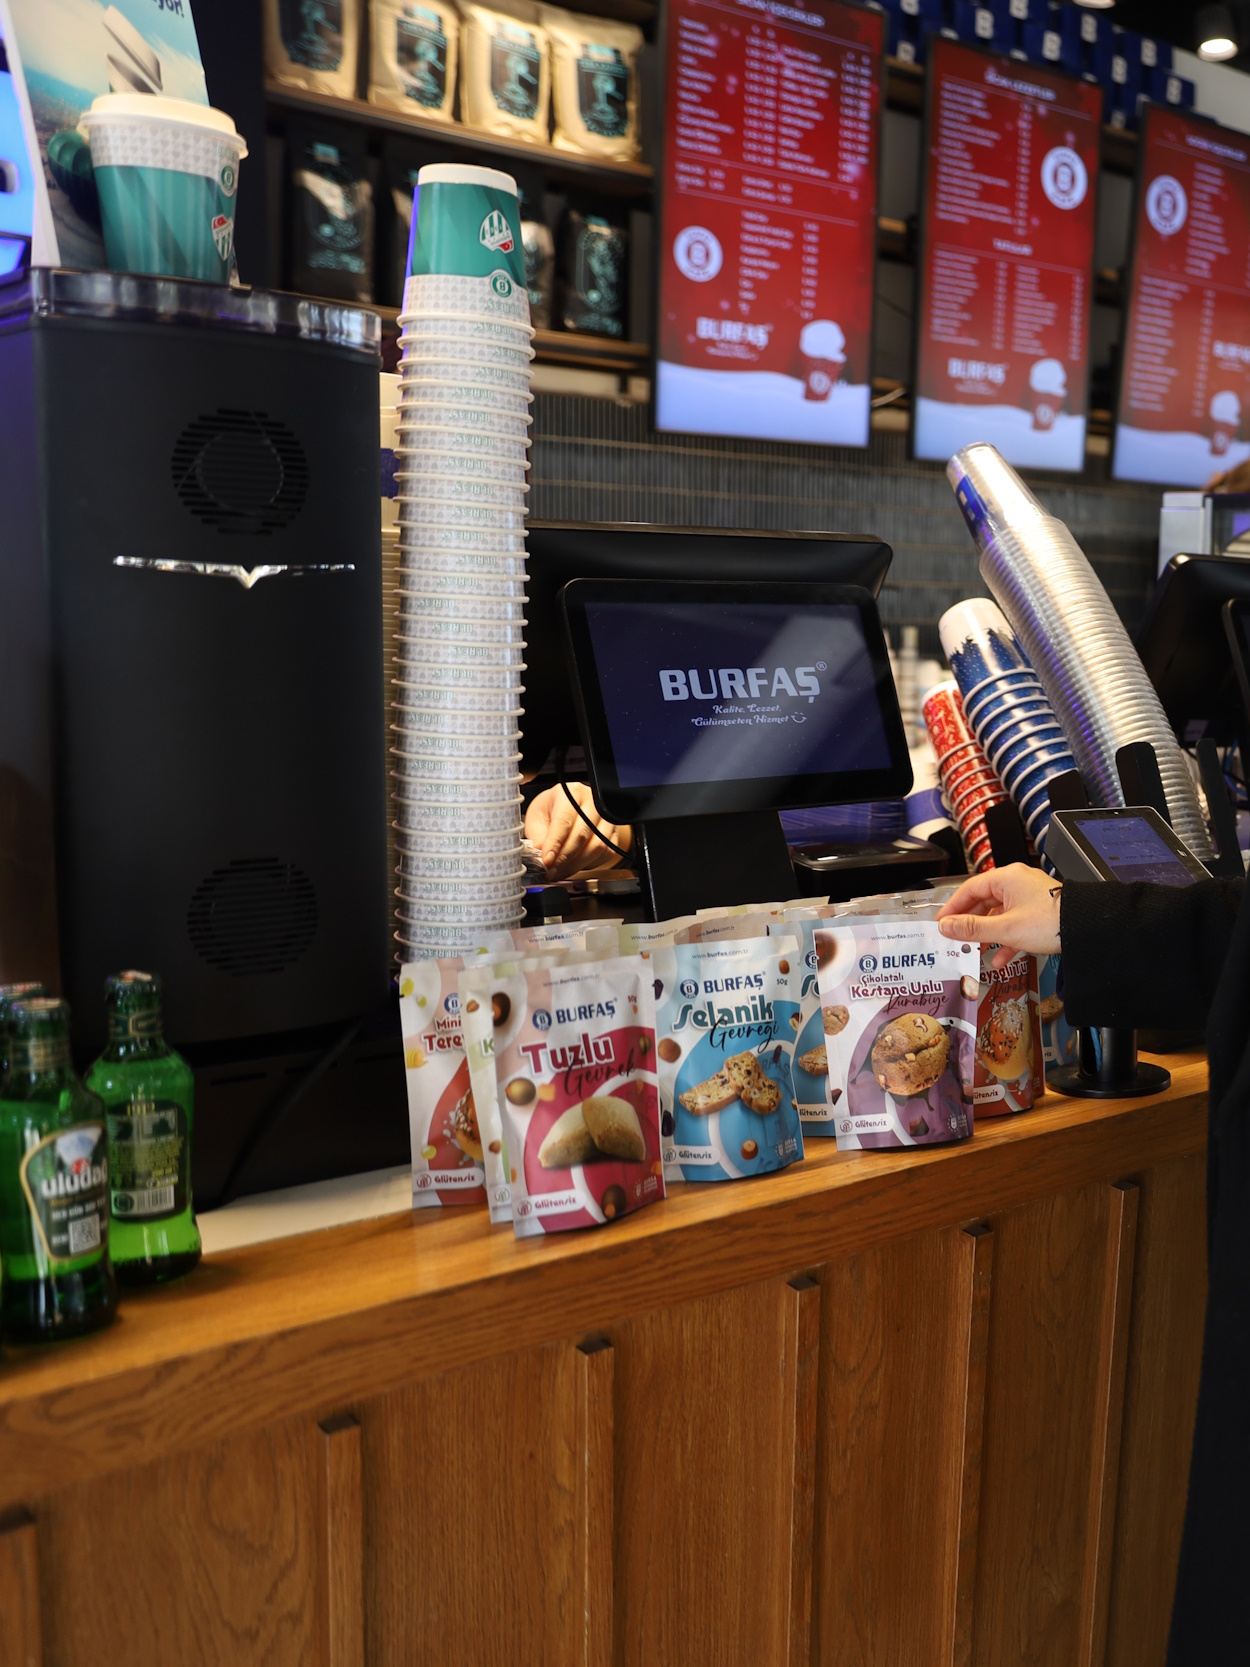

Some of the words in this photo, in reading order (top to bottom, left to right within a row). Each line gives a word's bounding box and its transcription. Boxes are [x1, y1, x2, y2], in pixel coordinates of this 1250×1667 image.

[659, 666, 820, 703] BURFAŞ
[871, 932, 925, 941] www.burfas.com.tr
[692, 949, 748, 960] www.burfas.com.tr
[882, 953, 936, 969] BURFAŞ
[704, 974, 764, 994] BURFAŞ
[851, 986, 907, 998] Kestane
[911, 980, 942, 994] Unlu
[862, 972, 904, 986] Çikolatalı
[556, 1000, 616, 1025] BURFAŞ
[673, 994, 774, 1030] Selanik
[883, 990, 949, 1015] Kurabiye
[709, 1019, 779, 1053] Gevreği
[522, 1034, 613, 1074] Tuzlu
[564, 1048, 636, 1097] Gevrek
[799, 1107, 828, 1116] lütensiz
